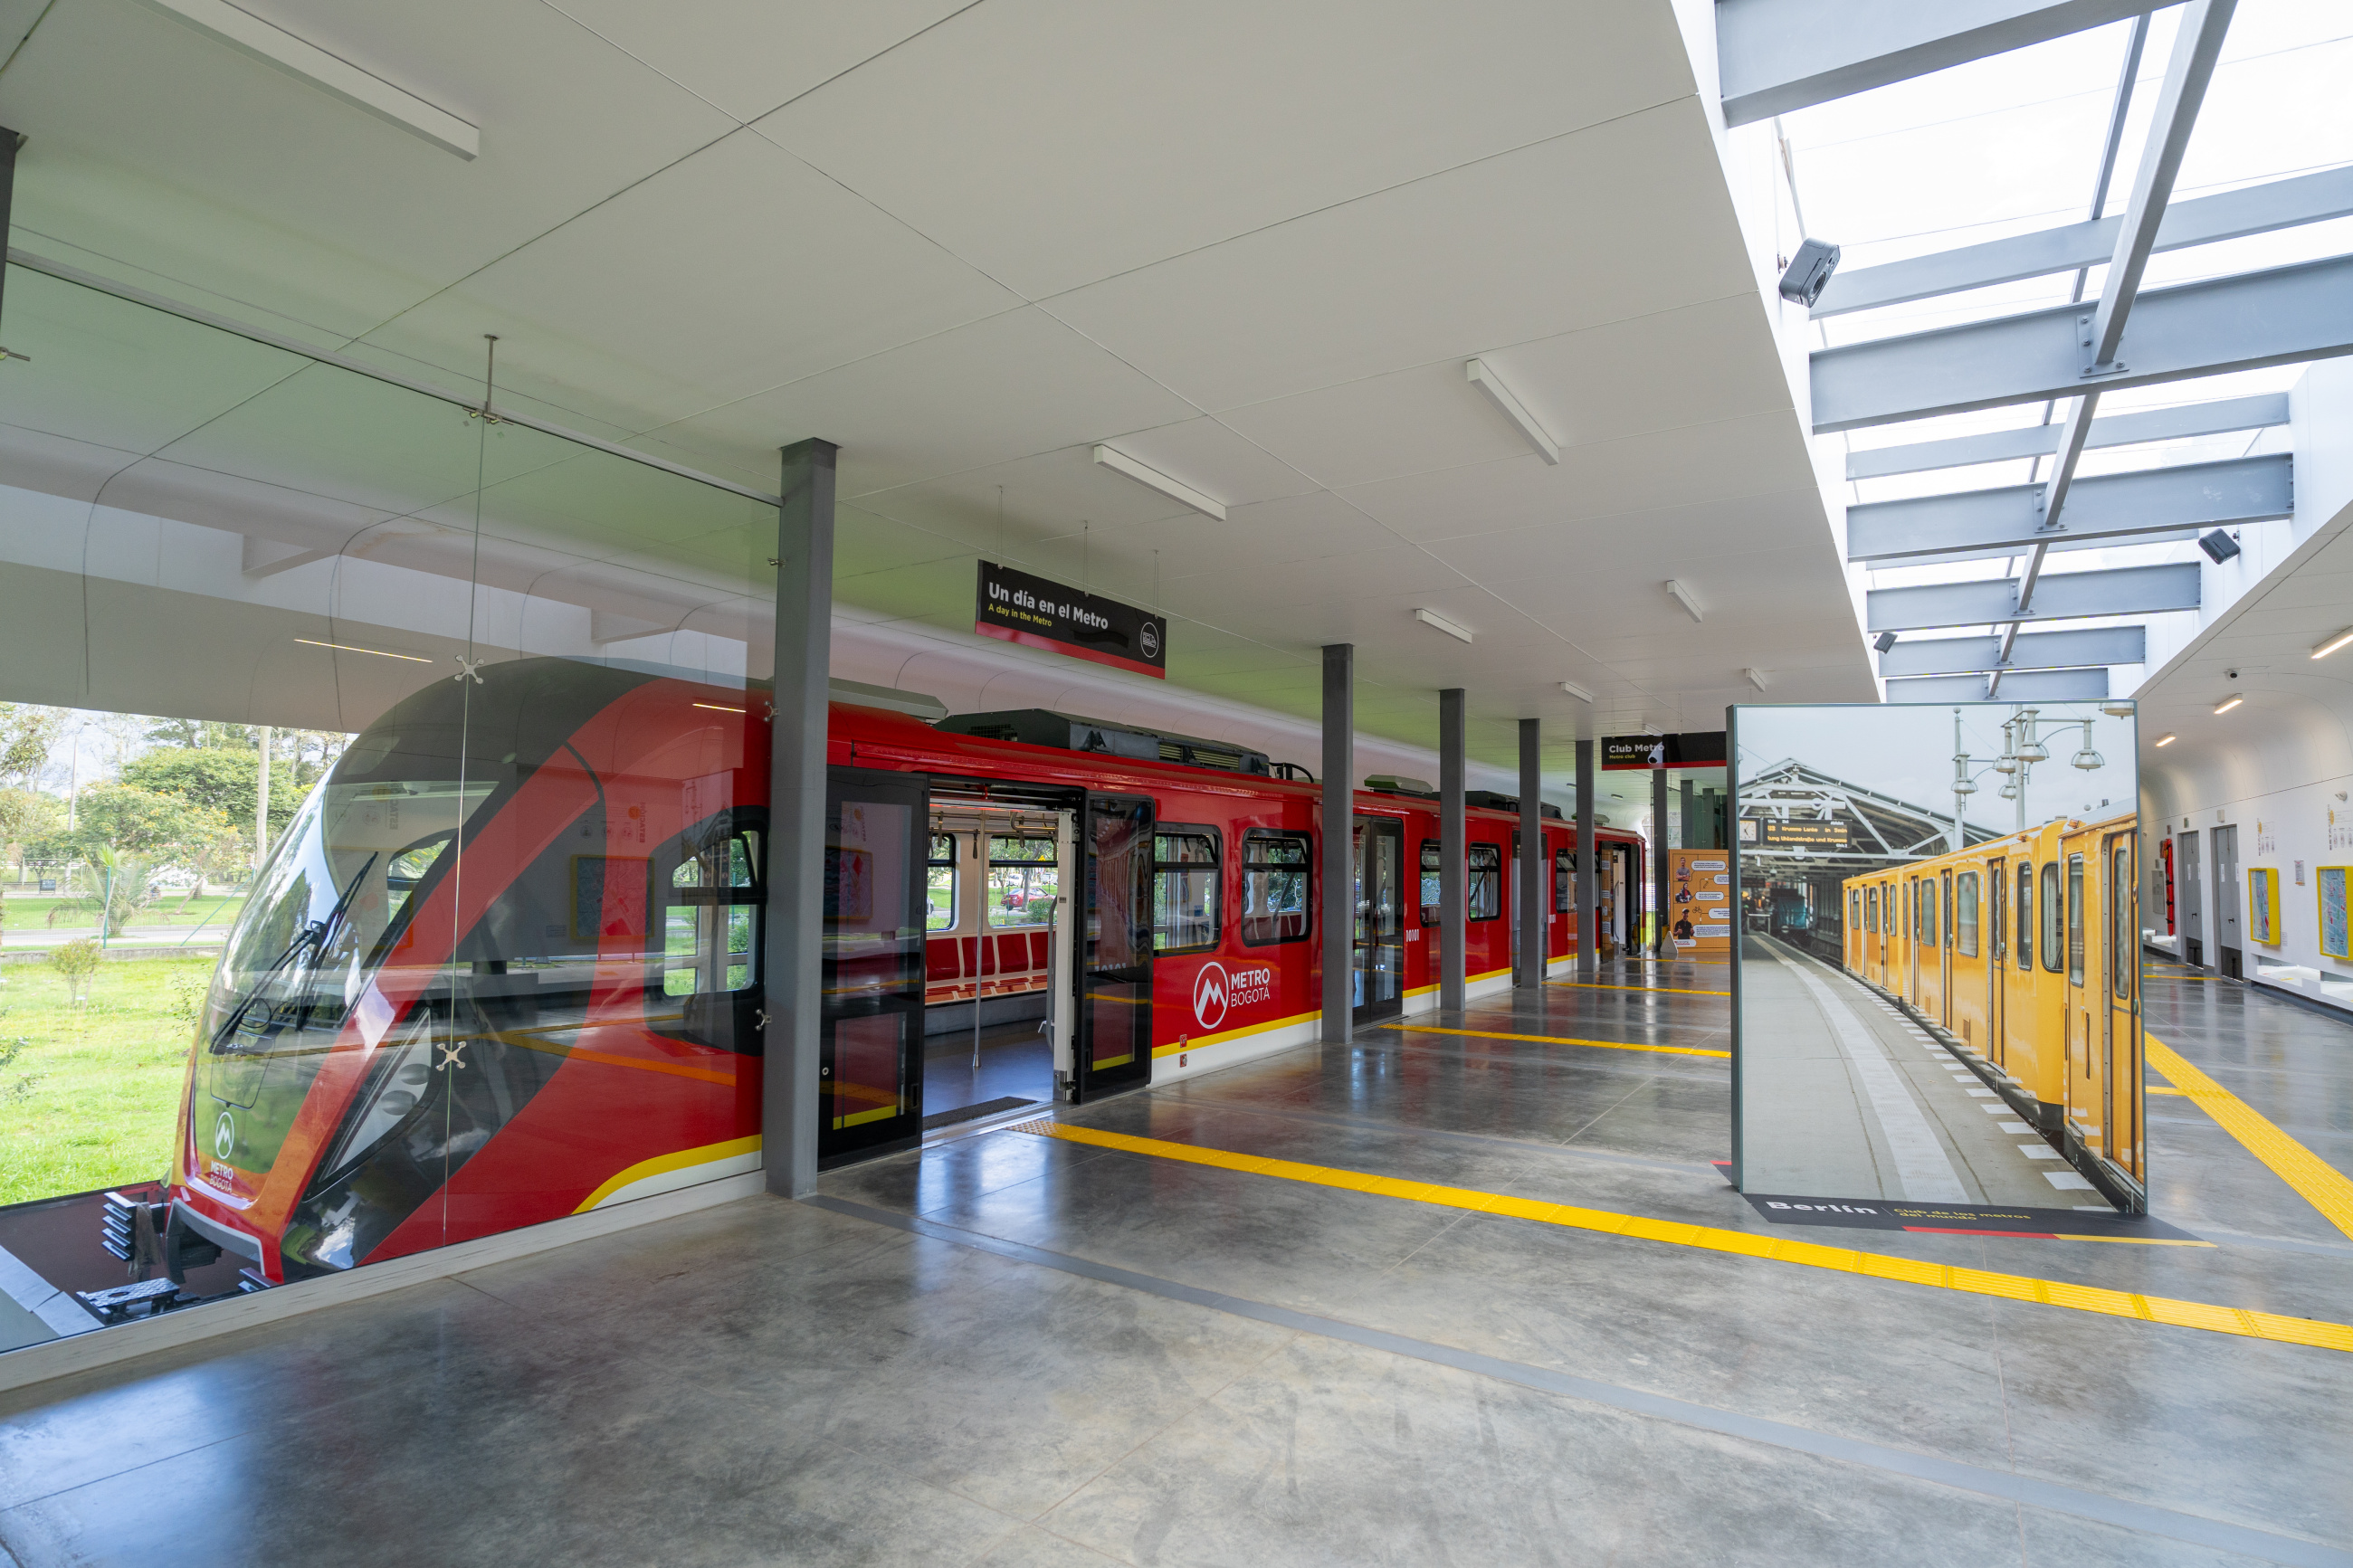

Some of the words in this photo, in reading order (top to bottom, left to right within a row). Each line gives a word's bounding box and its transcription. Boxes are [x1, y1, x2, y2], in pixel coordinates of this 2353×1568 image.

[988, 582, 1009, 603] Un
[1013, 589, 1035, 609] día
[1039, 600, 1055, 615] en
[1058, 603, 1070, 619] el
[1073, 606, 1109, 630] Metro
[988, 603, 995, 613] A
[996, 605, 1010, 617] day
[1011, 608, 1018, 618] in
[1019, 610, 1032, 622] the
[1033, 614, 1053, 627] Metro
[1609, 745, 1633, 753] Club
[1634, 744, 1665, 752] Metro
[1231, 968, 1270, 990] METRO
[1231, 984, 1271, 1007] BOGOTÁ
[210, 1161, 233, 1180] METRO
[209, 1174, 233, 1193] BOGOTÁ
